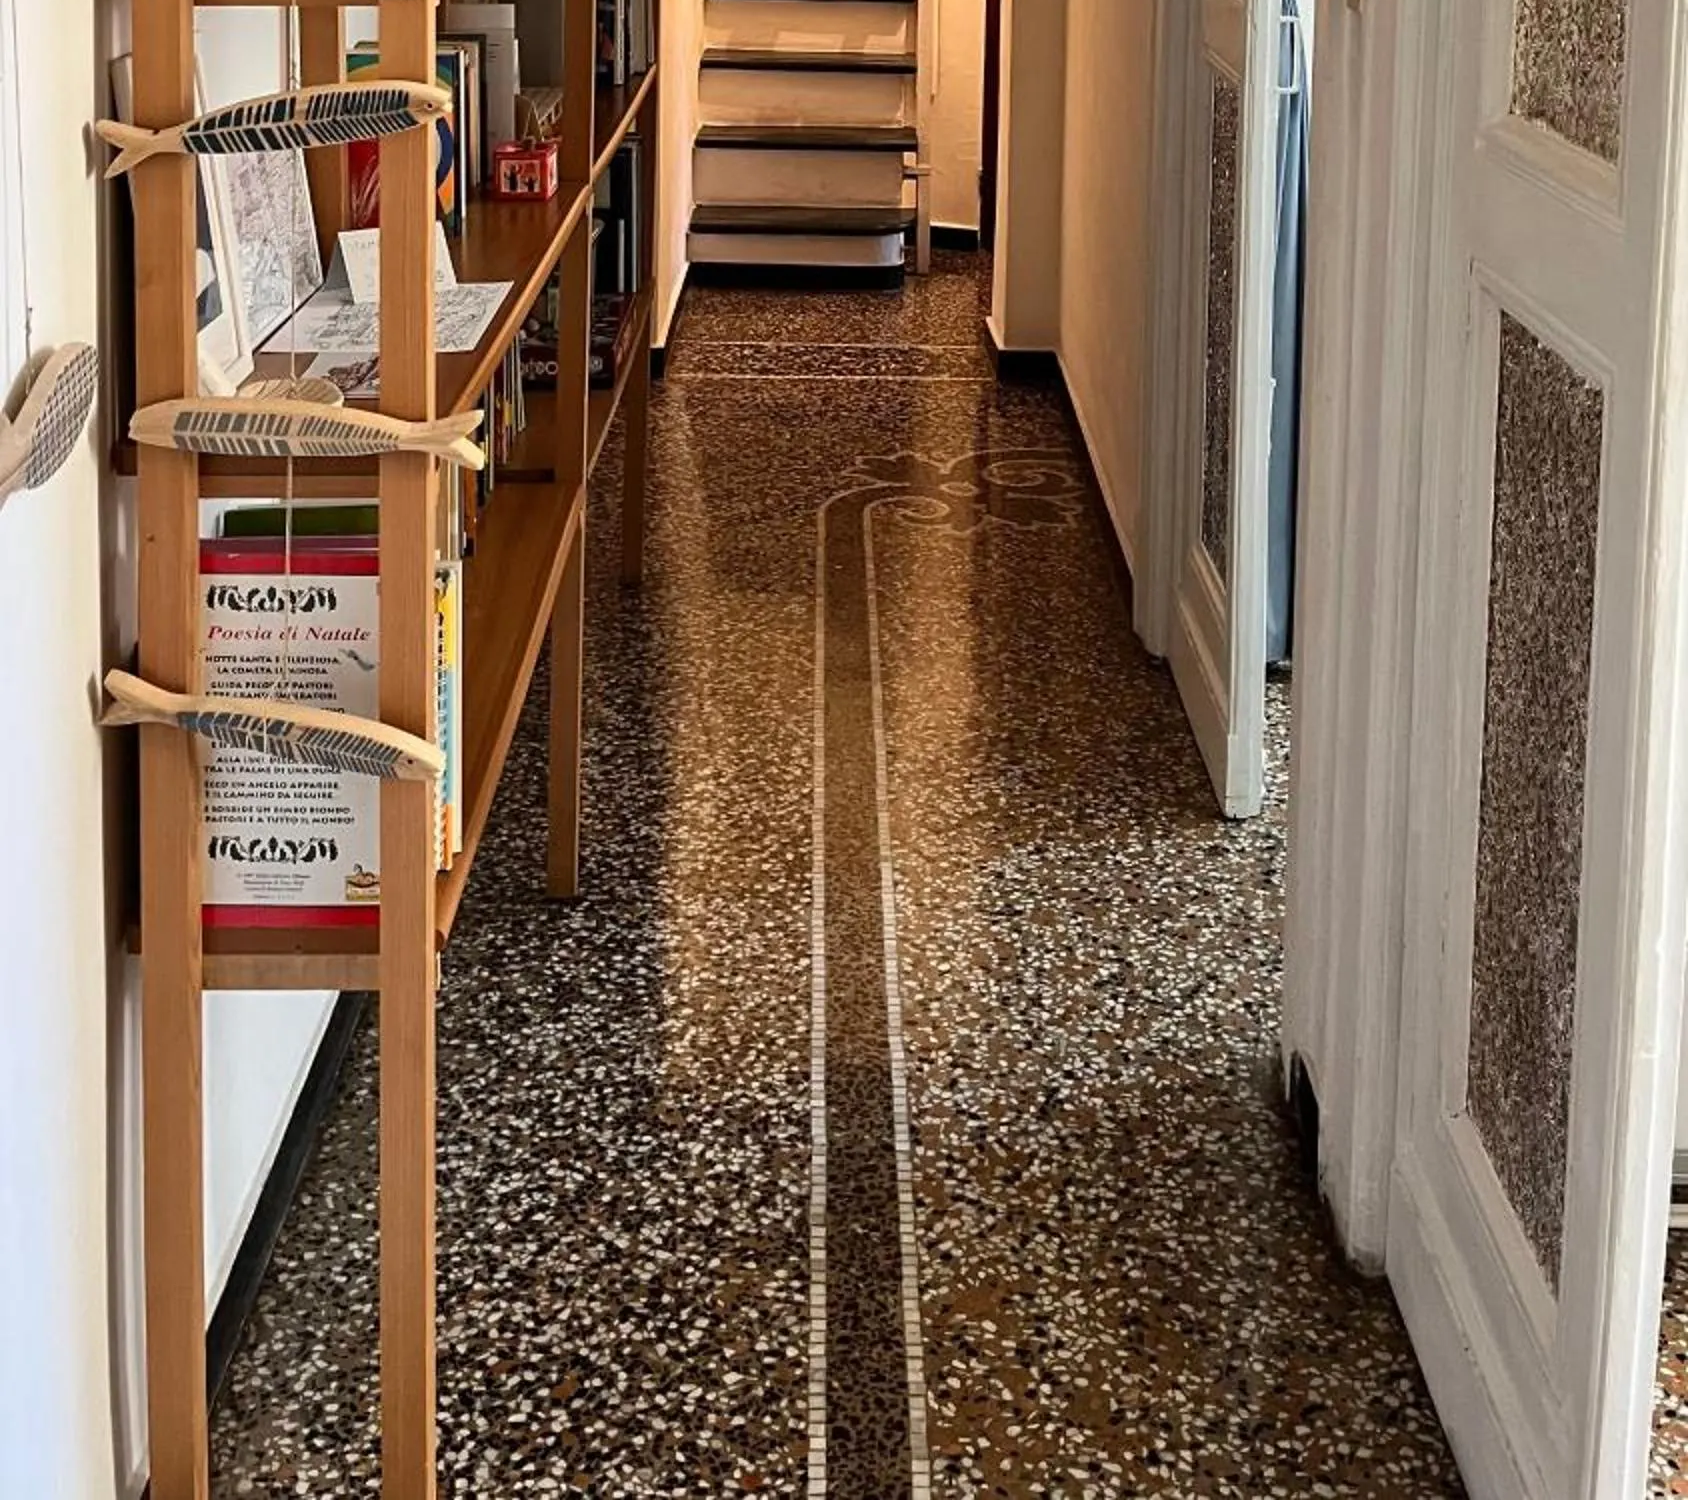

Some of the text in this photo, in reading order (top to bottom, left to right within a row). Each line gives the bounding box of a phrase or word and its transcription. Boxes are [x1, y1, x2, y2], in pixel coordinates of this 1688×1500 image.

[207, 625, 371, 642] Poesia di Natale
[205, 655, 237, 663] NOTTE
[240, 655, 272, 663] SANTA
